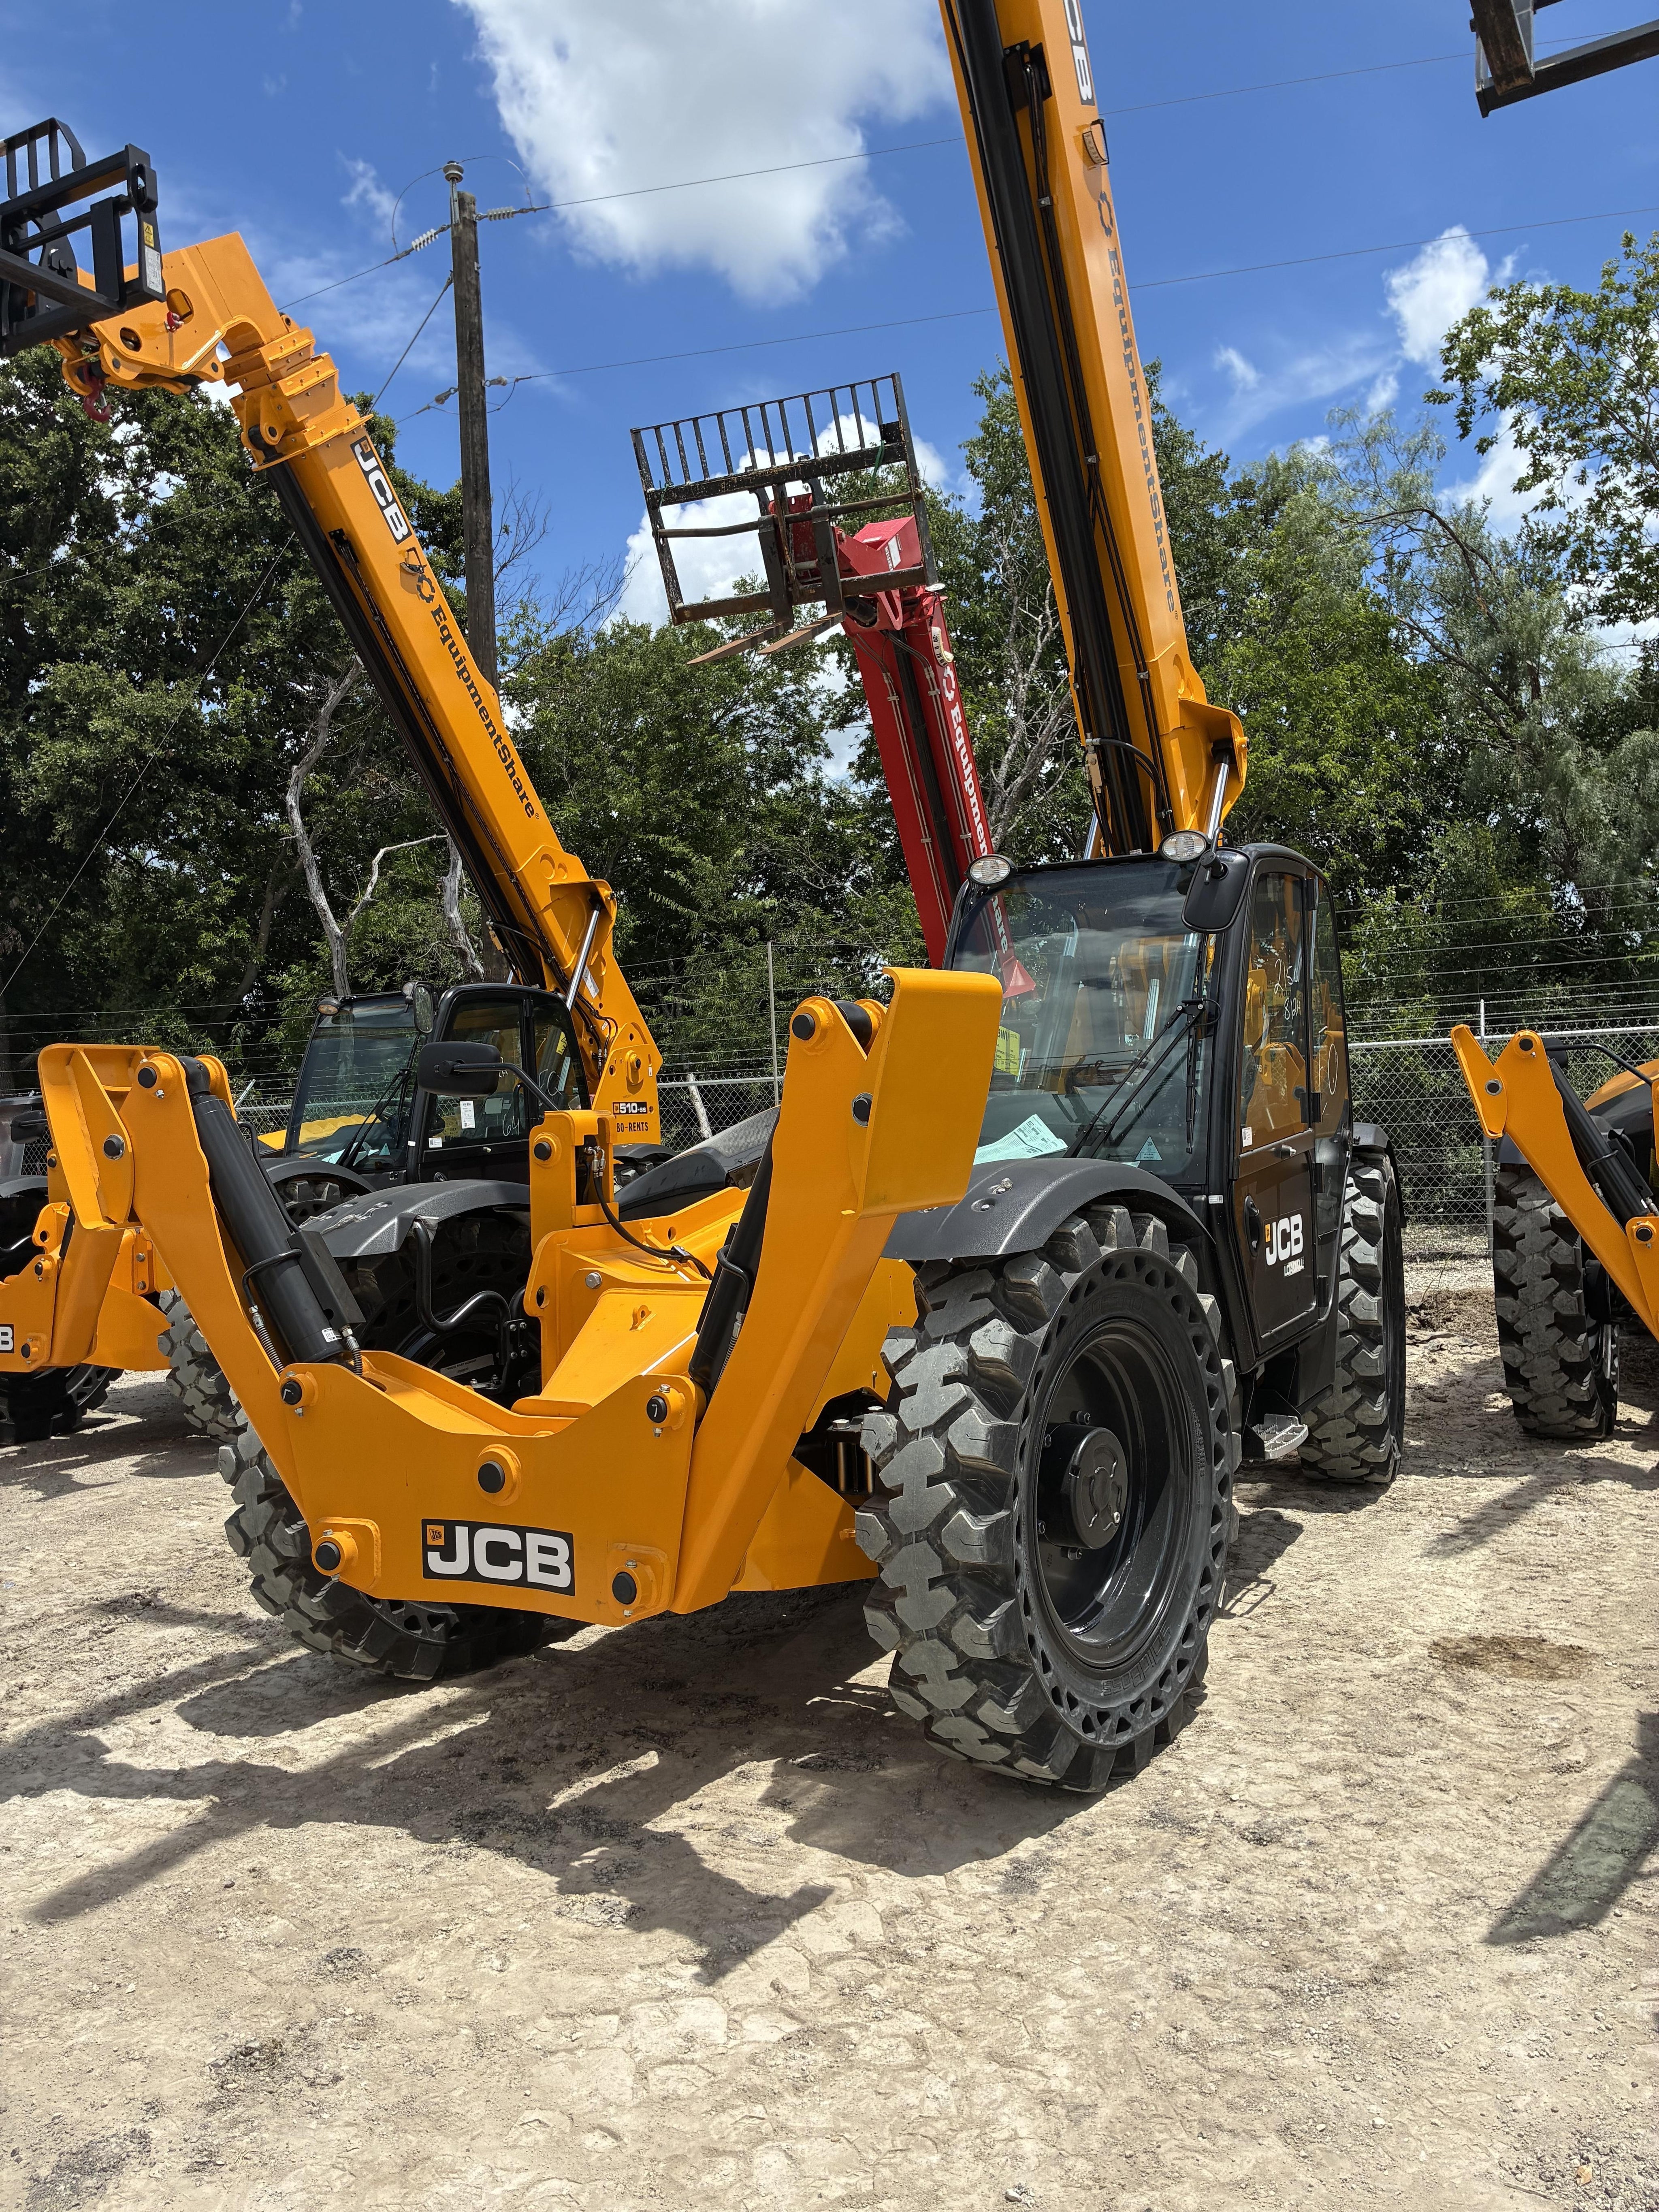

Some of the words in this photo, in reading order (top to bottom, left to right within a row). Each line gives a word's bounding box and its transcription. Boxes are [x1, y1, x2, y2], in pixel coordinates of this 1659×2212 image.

[354, 444, 408, 540] JCB
[1266, 1214, 1303, 1266] JCB
[427, 1526, 571, 1588] JCB
